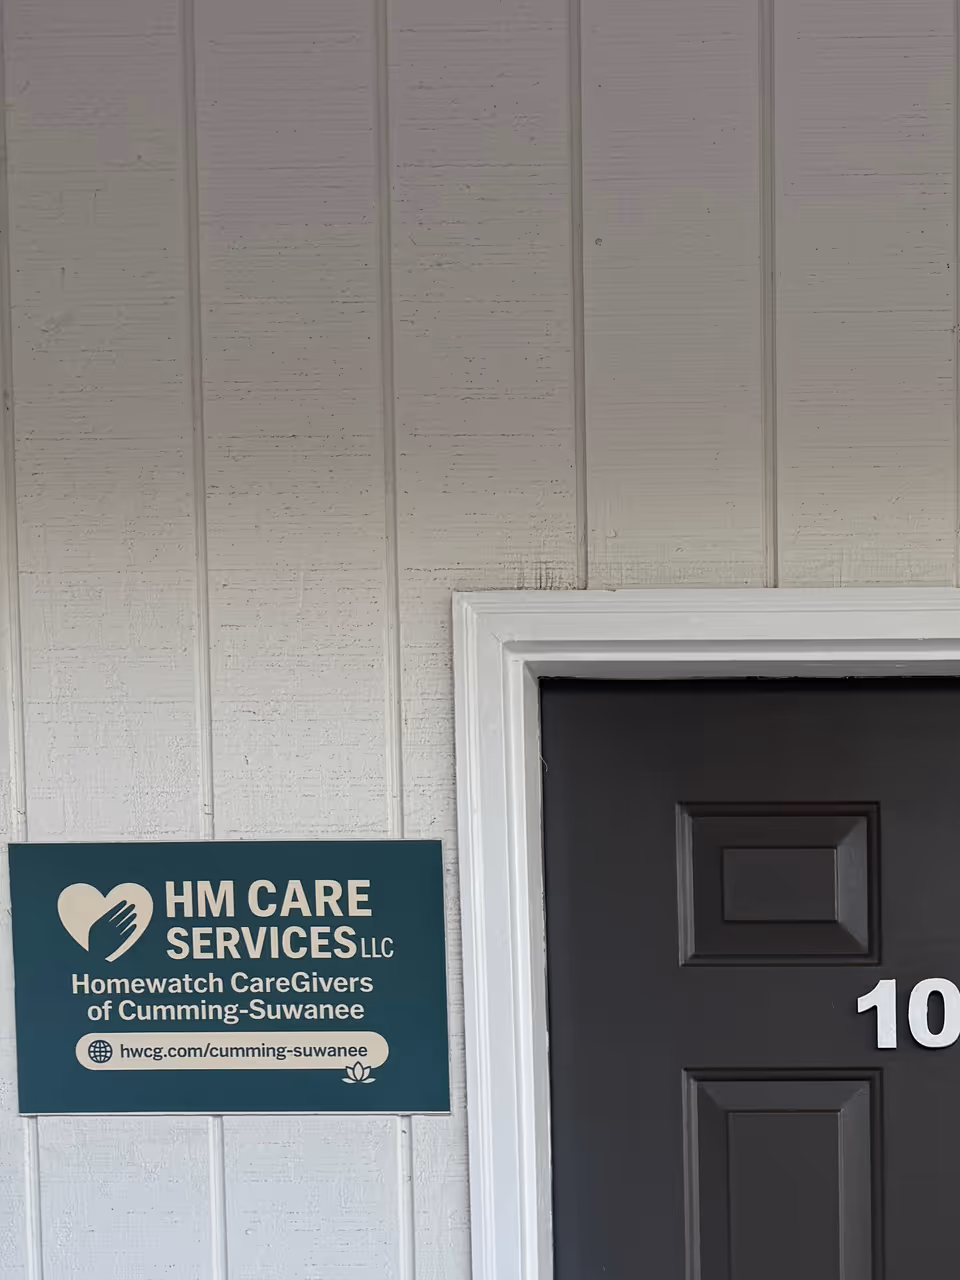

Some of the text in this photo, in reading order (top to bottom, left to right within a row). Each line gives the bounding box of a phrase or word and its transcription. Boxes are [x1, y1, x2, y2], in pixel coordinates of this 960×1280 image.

[165, 880, 372, 918] HM CARE
[166, 926, 395, 960] SERVICES LLC
[72, 971, 374, 995] Homewatch CareGivers
[87, 999, 365, 1024] of Cumming-Suwanee
[119, 1042, 368, 1060] hwcg.com/cumming-suwanee
